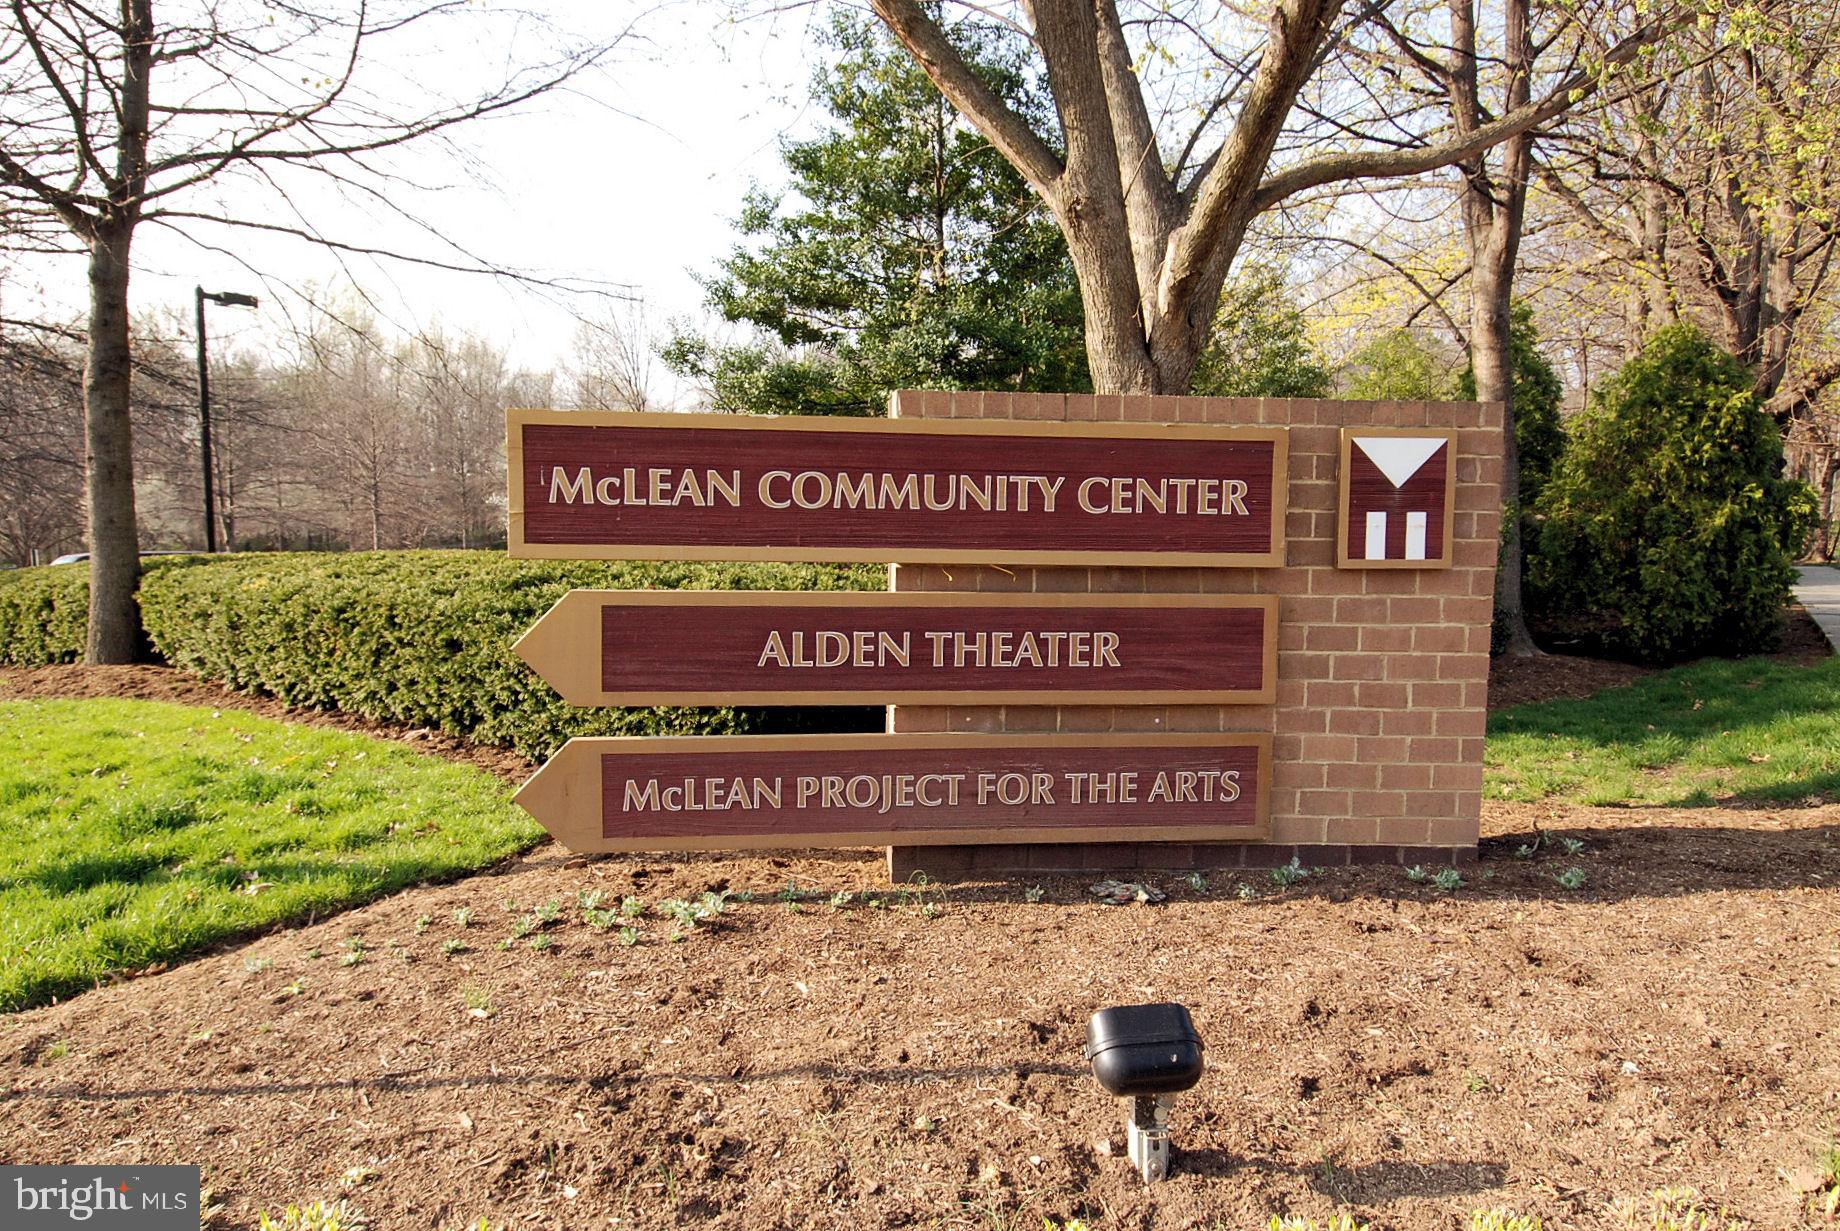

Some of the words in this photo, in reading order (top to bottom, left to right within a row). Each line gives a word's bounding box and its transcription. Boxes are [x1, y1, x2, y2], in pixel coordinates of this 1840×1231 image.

[548, 466, 741, 507] McLEAN
[758, 470, 1066, 512] COMMUNITY
[1077, 476, 1250, 516] CENTER
[757, 630, 911, 668] ALDEN
[925, 631, 1121, 668] THEATER
[622, 777, 782, 812] McLEAN
[796, 773, 966, 814] PROJECT
[978, 773, 1056, 805] FOR
[1065, 772, 1138, 804] THE
[1148, 770, 1241, 803] ARTS
